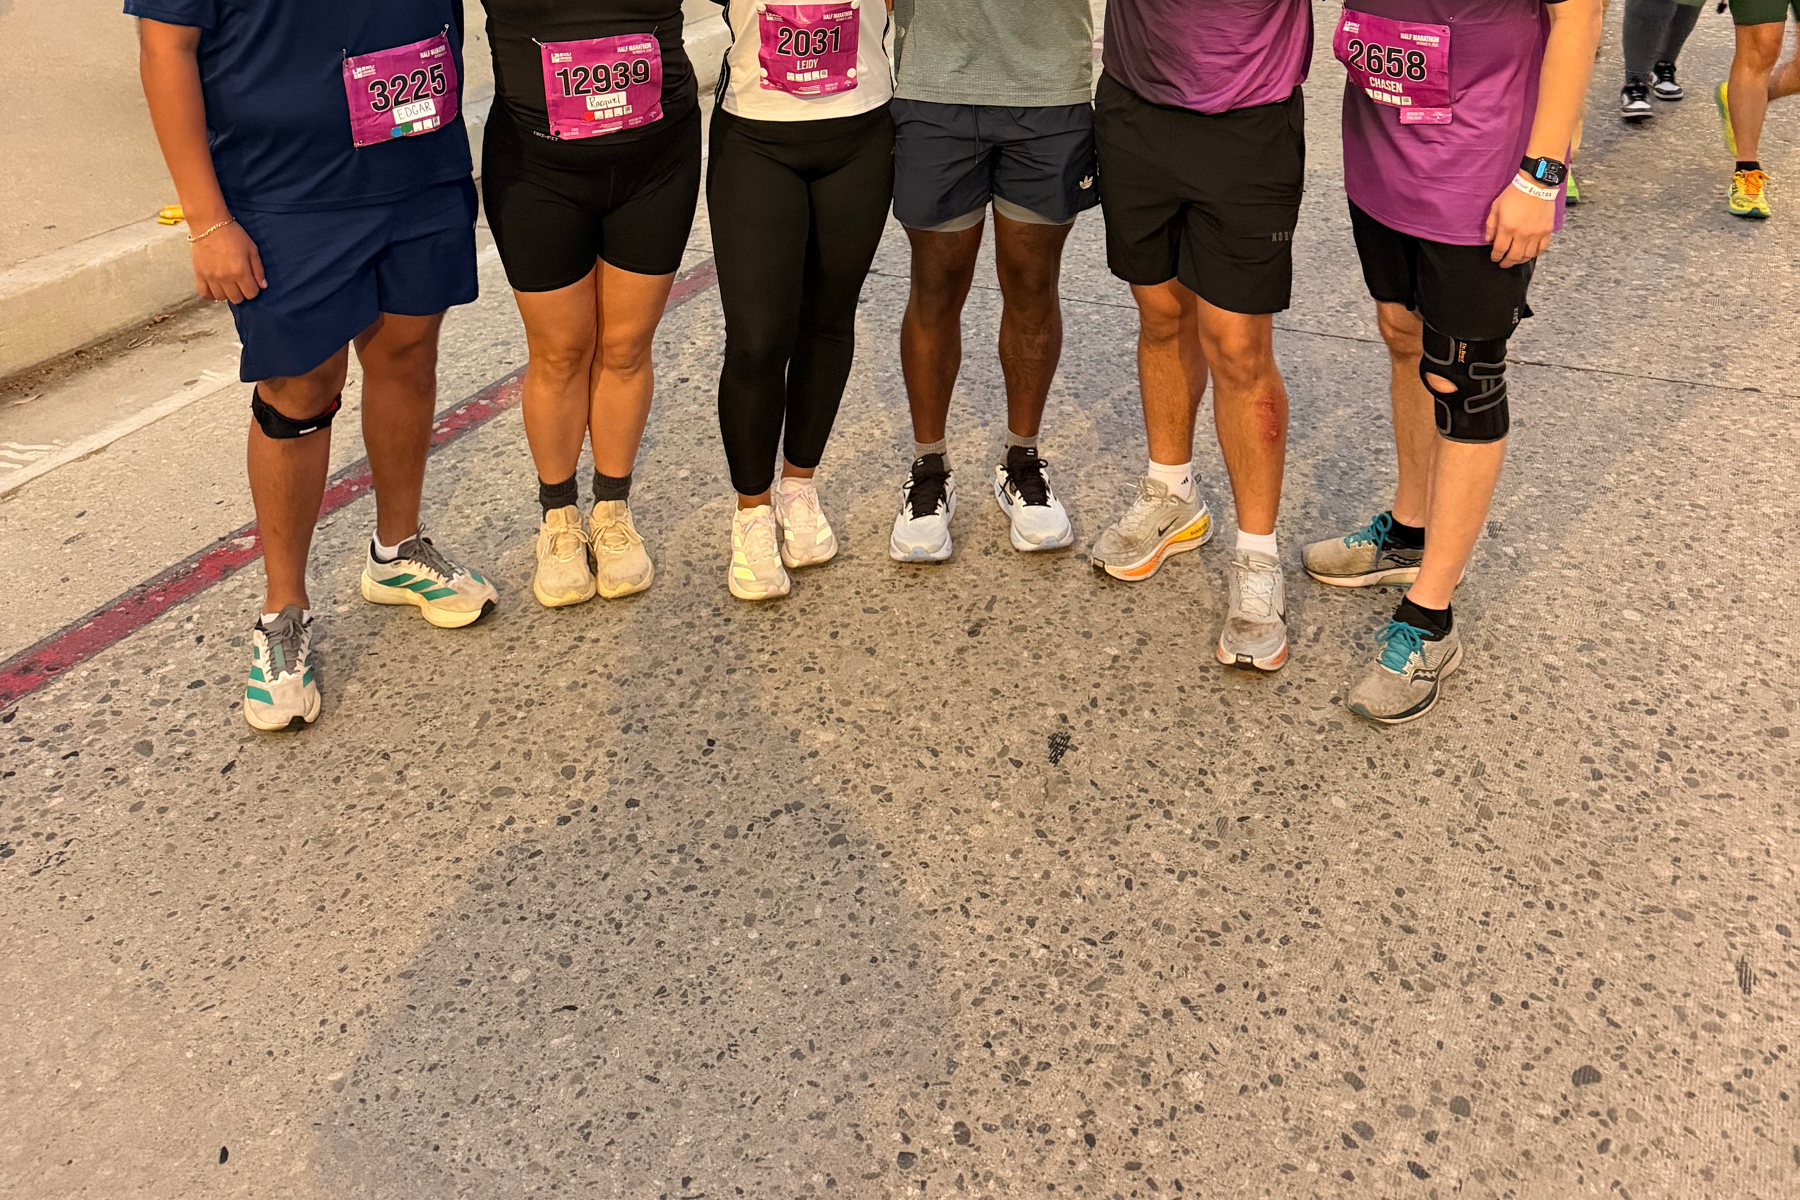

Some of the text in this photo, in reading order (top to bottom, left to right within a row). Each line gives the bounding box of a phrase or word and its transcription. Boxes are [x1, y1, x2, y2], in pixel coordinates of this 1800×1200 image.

[776, 25, 841, 58] 2031
[796, 58, 819, 71] LEIDY
[1348, 38, 1427, 82] 2658
[368, 62, 447, 112] 3225
[555, 57, 651, 98] 12939
[1369, 76, 1403, 94] CHASEN
[396, 102, 434, 121] EDGAR
